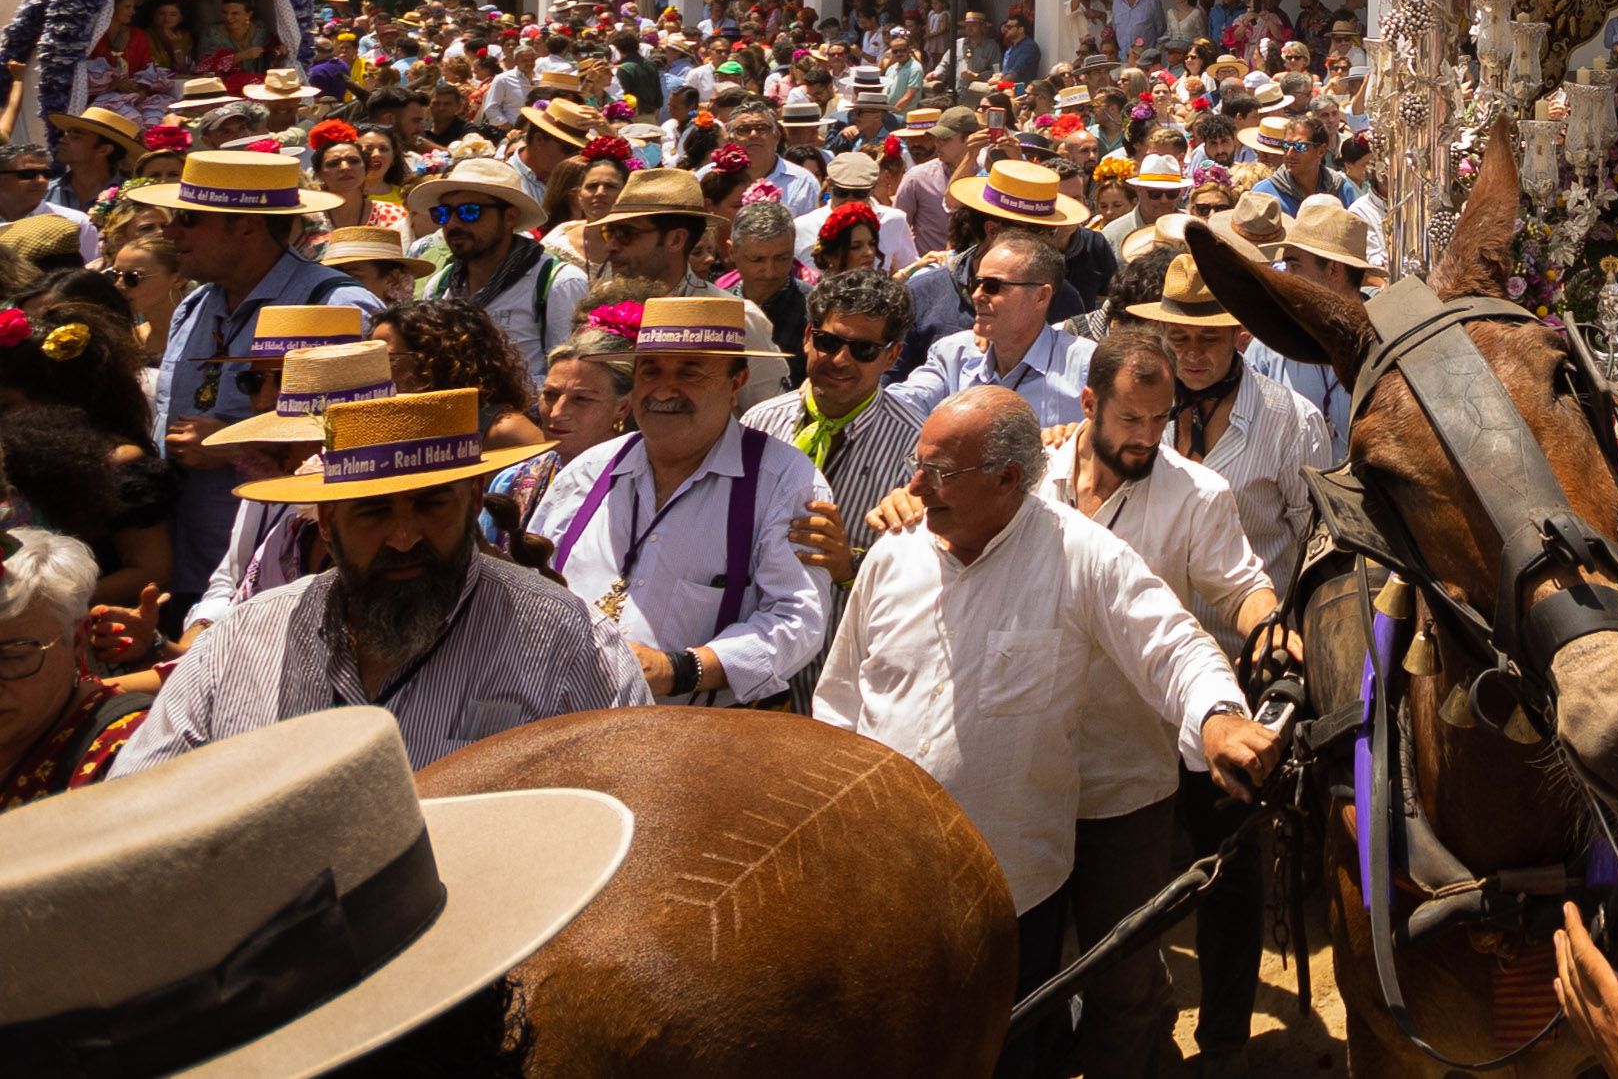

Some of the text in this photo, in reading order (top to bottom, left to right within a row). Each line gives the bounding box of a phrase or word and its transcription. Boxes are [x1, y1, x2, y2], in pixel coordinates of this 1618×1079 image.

[198, 190, 208, 201] del
[286, 341, 299, 349] del
[343, 456, 376, 475] Paloma
[394, 448, 422, 469] Real
[425, 443, 454, 464] Hdad.
[457, 440, 468, 458] del
